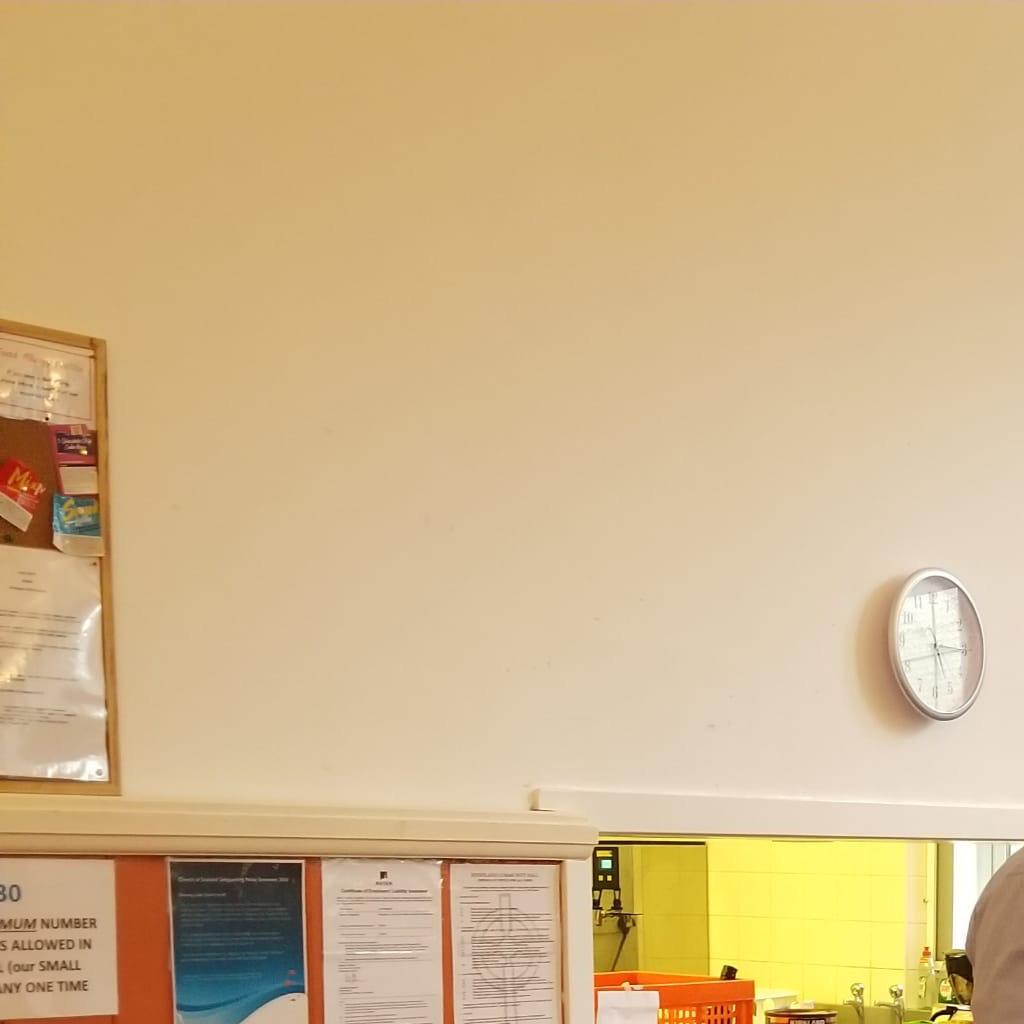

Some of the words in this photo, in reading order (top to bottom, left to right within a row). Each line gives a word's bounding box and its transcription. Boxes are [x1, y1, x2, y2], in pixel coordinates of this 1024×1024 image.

[40, 917, 97, 929] NUMBER
[11, 939, 76, 951] ALLOWED
[78, 938, 92, 950] IN
[7, 960, 36, 975] (our
[39, 960, 82, 972] SMALL
[25, 981, 55, 993] ONE
[57, 980, 89, 992] TIME
